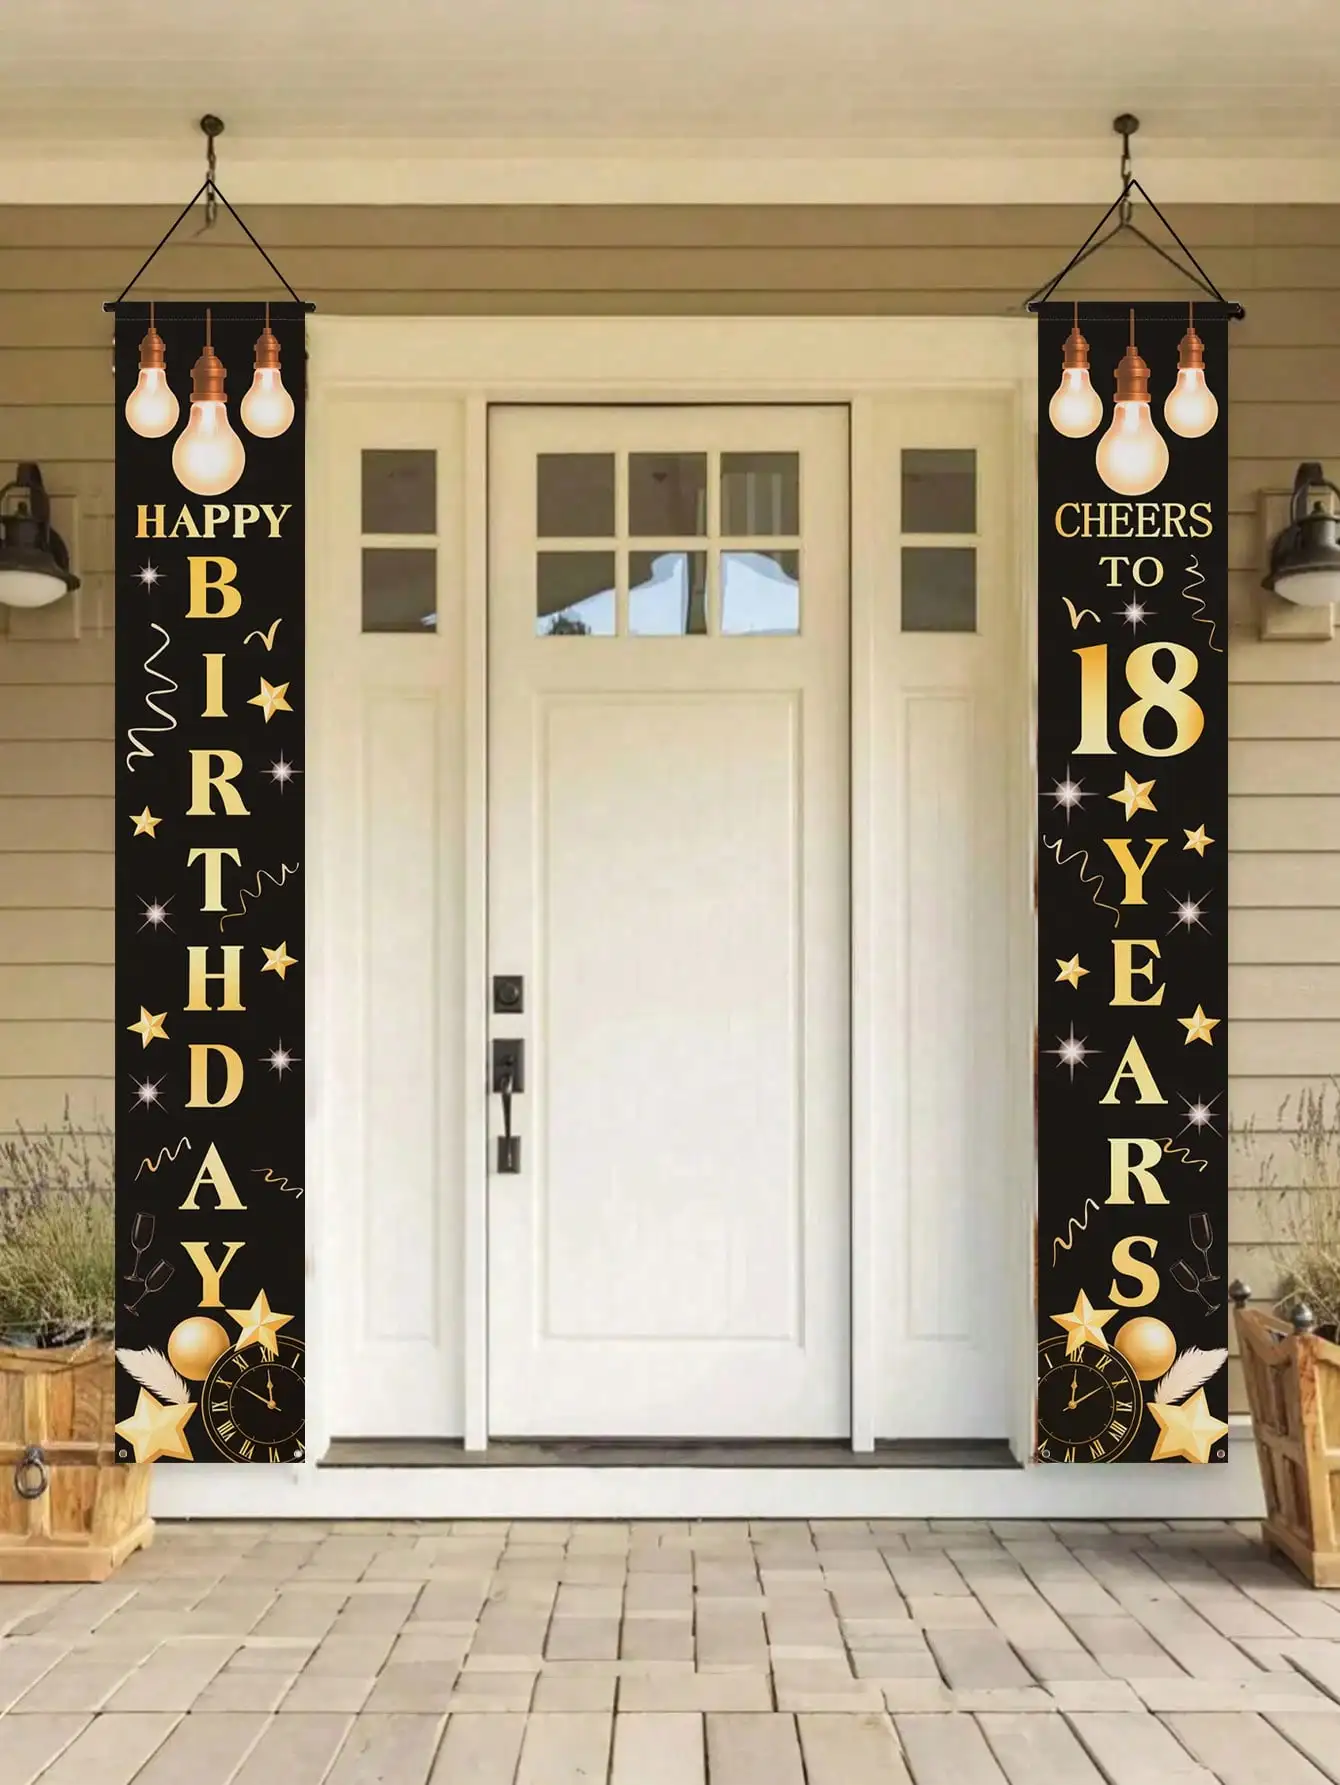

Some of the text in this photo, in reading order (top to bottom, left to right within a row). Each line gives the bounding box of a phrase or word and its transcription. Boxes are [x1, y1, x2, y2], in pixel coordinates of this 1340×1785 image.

[135, 503, 292, 539] HAPPY
[1054, 502, 1213, 538] CHEERS
[1098, 556, 1164, 588] TO
[1072, 641, 1205, 758] 18
[179, 556, 250, 1308] BIRTHDAY
[1100, 838, 1170, 1308] YEARS
